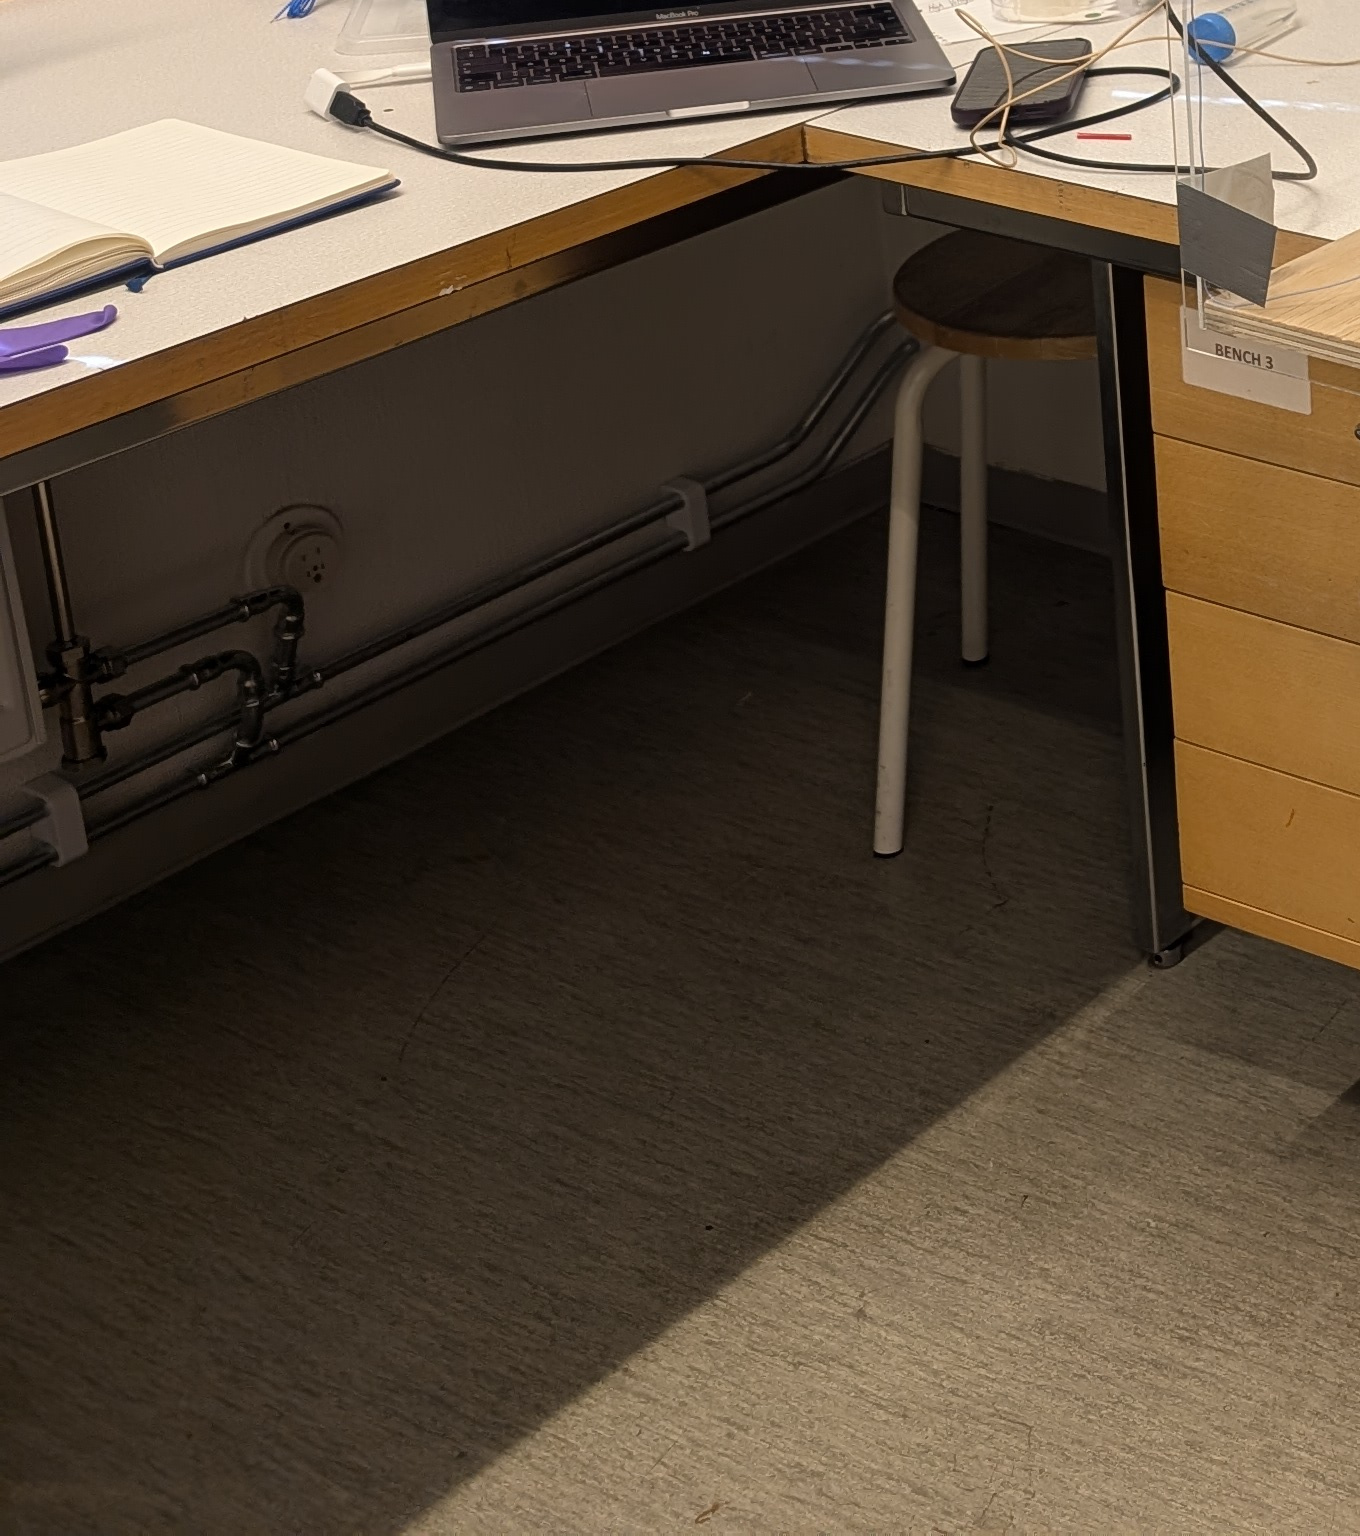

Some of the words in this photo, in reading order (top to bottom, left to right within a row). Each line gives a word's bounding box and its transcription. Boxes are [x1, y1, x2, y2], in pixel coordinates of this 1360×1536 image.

[656, 12, 686, 20] MacBook
[1215, 343, 1261, 366] BENCH
[1265, 356, 1274, 369] 3
